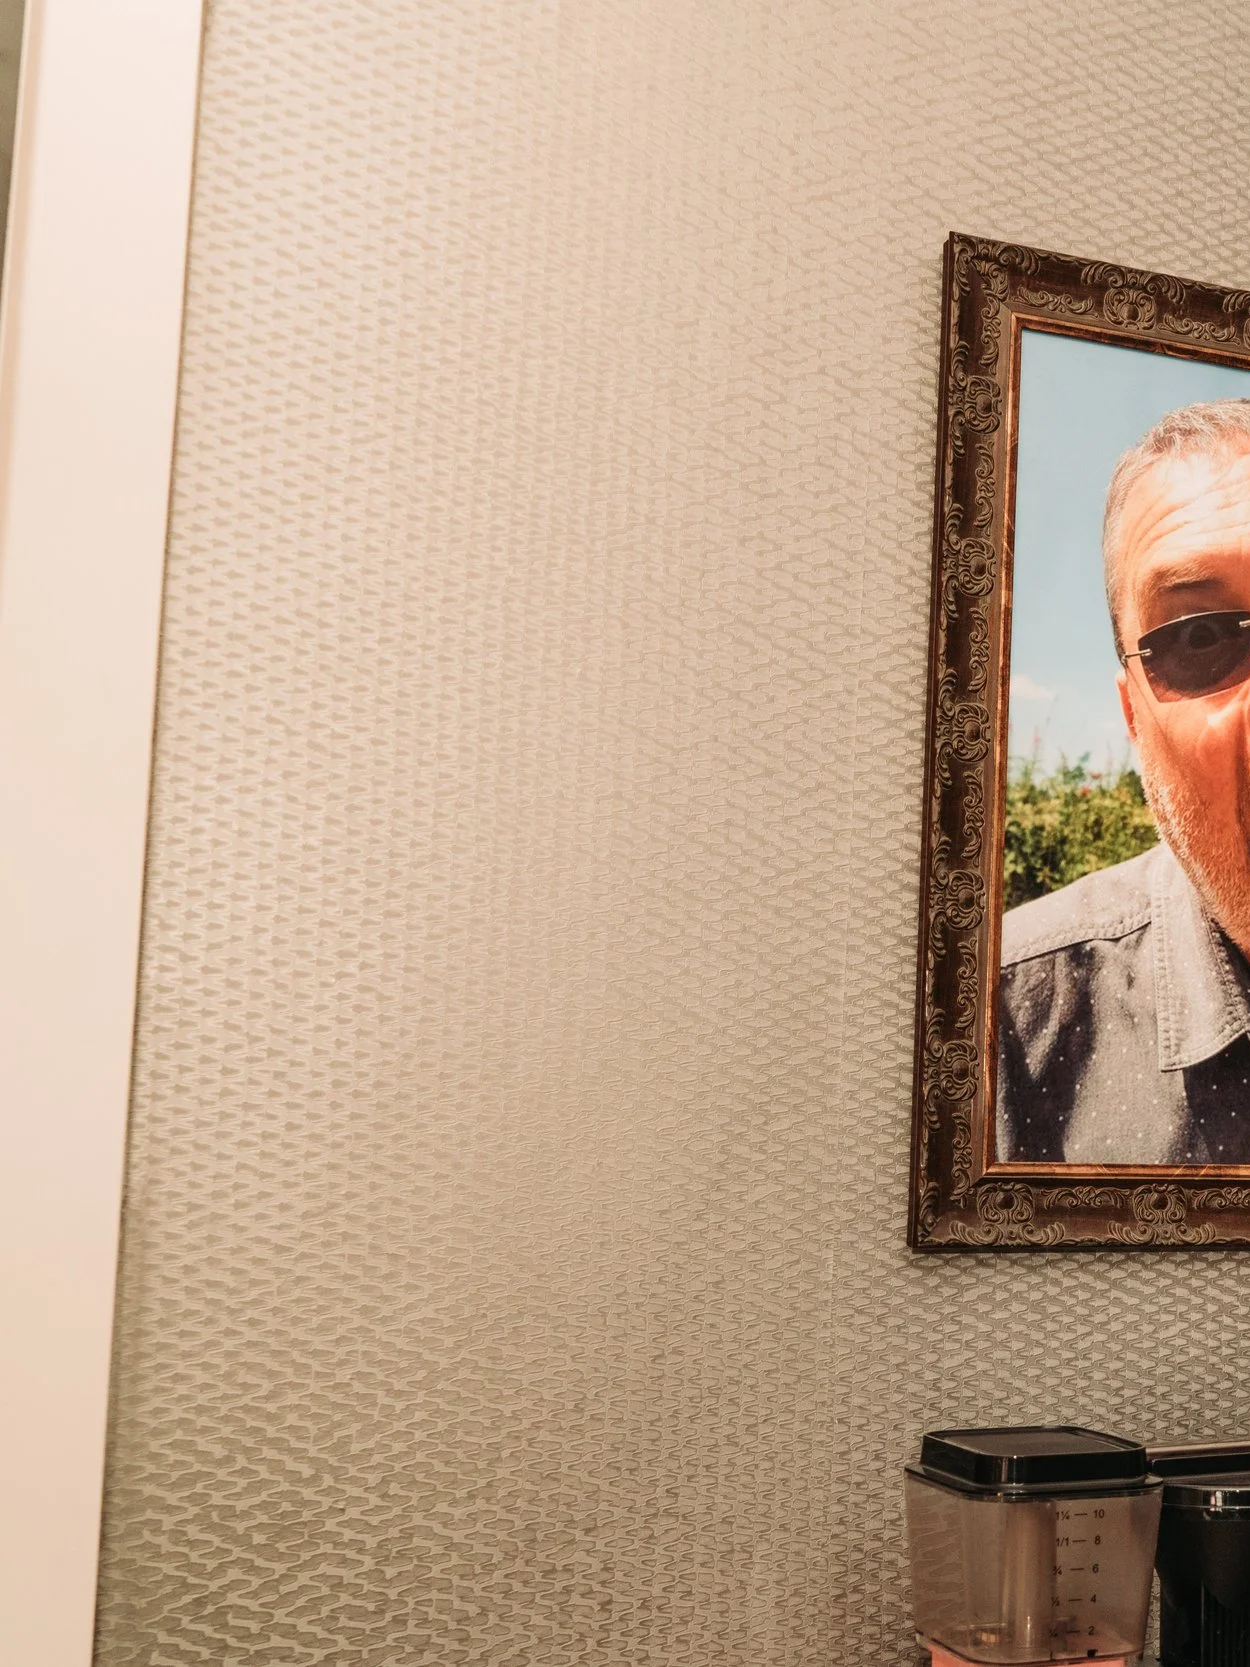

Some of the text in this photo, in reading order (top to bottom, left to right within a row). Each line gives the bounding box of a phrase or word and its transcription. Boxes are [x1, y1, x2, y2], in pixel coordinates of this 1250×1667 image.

[1093, 1508, 1105, 1519] 10
[1094, 1535, 1101, 1546] 8
[1092, 1563, 1099, 1574] 6
[1090, 1594, 1097, 1604] 4
[1088, 1625, 1095, 1636] 2
